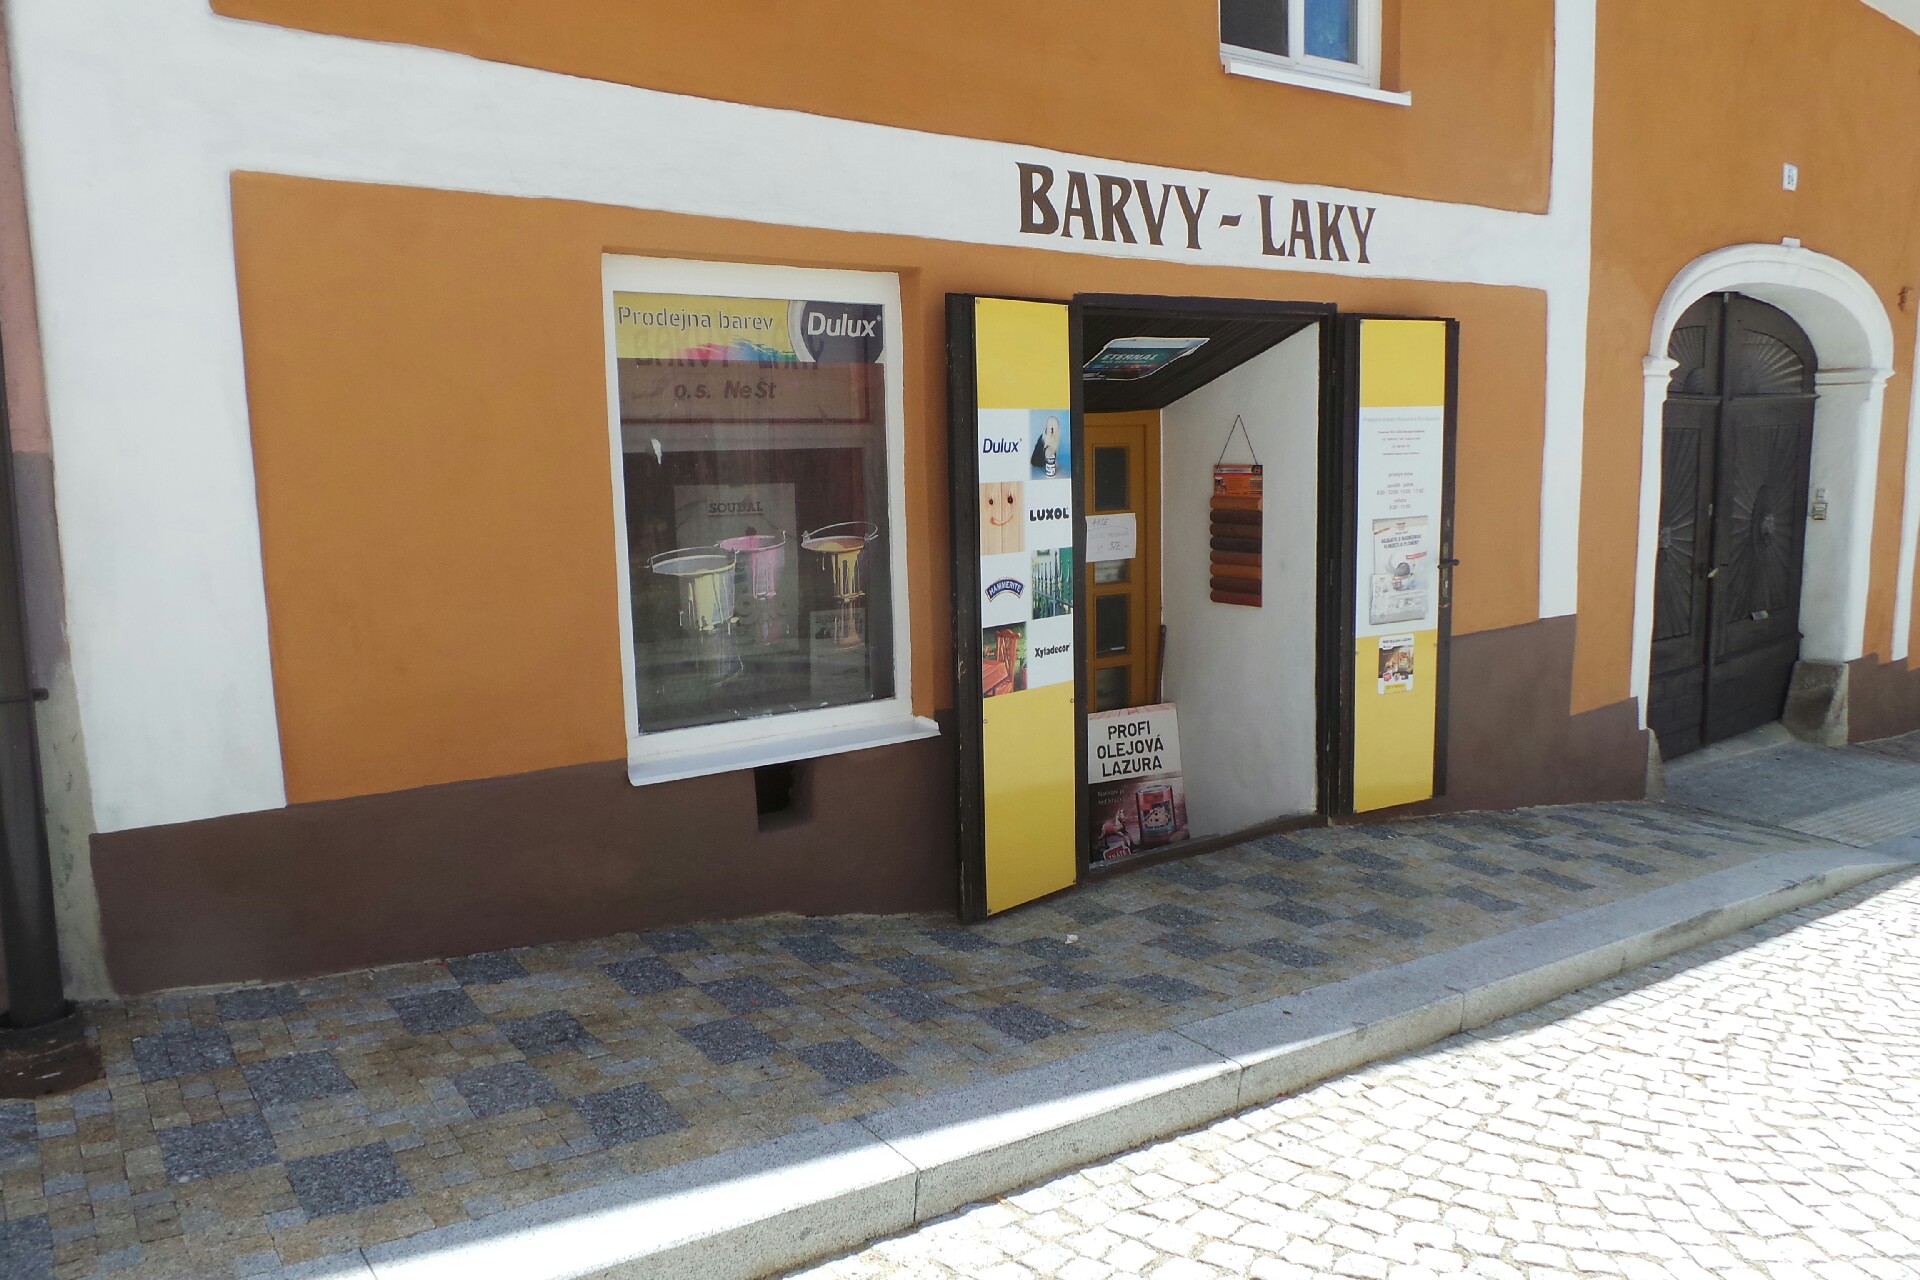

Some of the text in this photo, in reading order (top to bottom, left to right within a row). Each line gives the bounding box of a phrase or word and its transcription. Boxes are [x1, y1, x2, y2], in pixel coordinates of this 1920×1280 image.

[1015, 162, 1210, 250] BARVY
[1257, 194, 1377, 264] LAKY
[618, 306, 774, 331] Prodejna barev
[807, 312, 877, 338] Dulux
[982, 437, 1020, 454] Dulux
[708, 500, 764, 515] SOUDAL
[1029, 507, 1070, 522] LUXOL
[987, 579, 1022, 597] HAMMERITE
[1034, 643, 1070, 659] Xyladecor
[1107, 720, 1151, 740] PROFI
[1097, 734, 1164, 760] OLEJOVÁ
[1101, 755, 1163, 778] LAZURA
